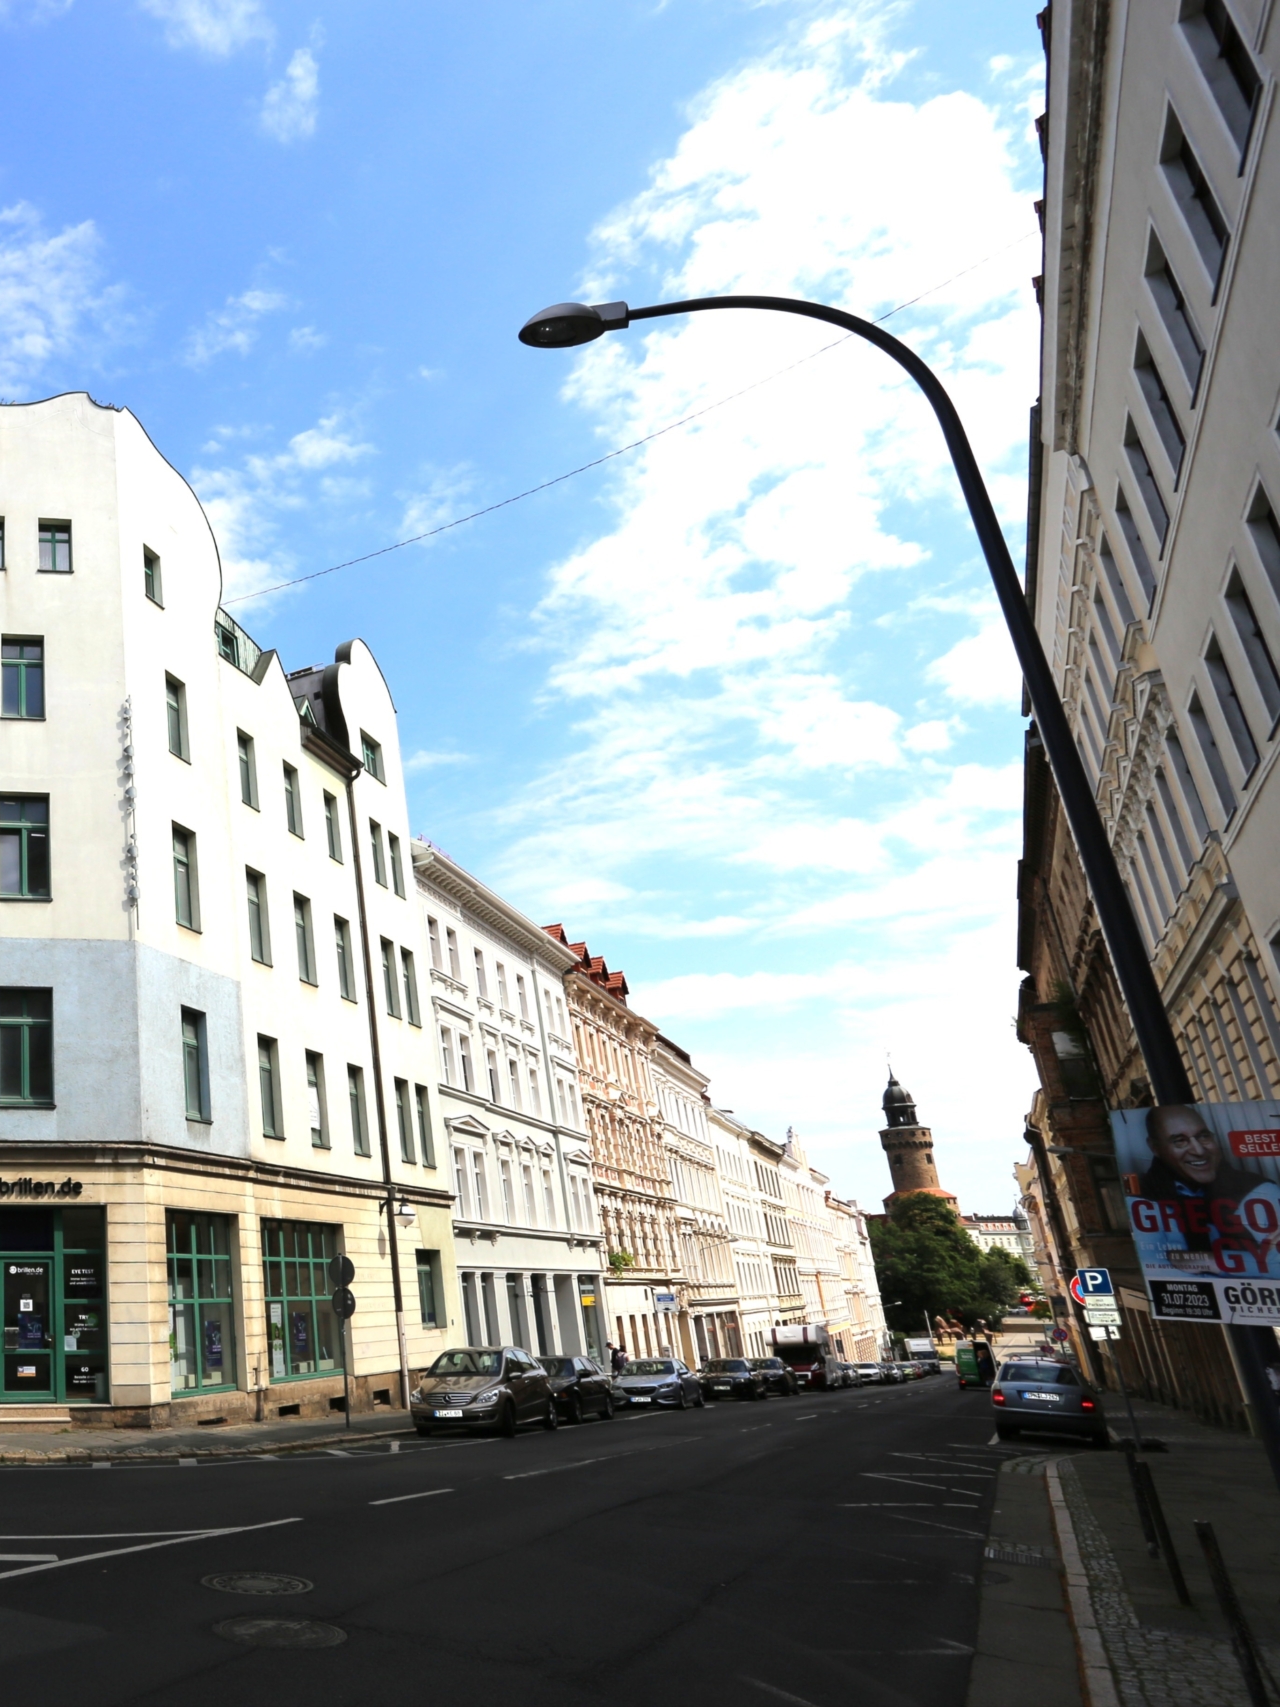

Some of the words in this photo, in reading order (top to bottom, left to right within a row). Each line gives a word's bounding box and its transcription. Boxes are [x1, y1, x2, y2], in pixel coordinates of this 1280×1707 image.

[1244, 1133, 1277, 1143] BEST
[1239, 1143, 1280, 1153] SELLE
[1131, 1198, 1280, 1234] GREGO
[1140, 1242, 1155, 1251] Ein
[1157, 1242, 1183, 1251] Leben
[1183, 1252, 1210, 1262] wenig
[1212, 1238, 1280, 1274] GY
[1158, 1263, 1211, 1271] AUTOBIOGRAPHIE
[1085, 1272, 1103, 1292] P
[1166, 1283, 1199, 1293] MONTAG
[1161, 1293, 1210, 1307] 31.07.2023
[1161, 1306, 1186, 1316] Beginn:
[1186, 1308, 1201, 1316] 19:30
[1201, 1308, 1213, 1316] Uhr
